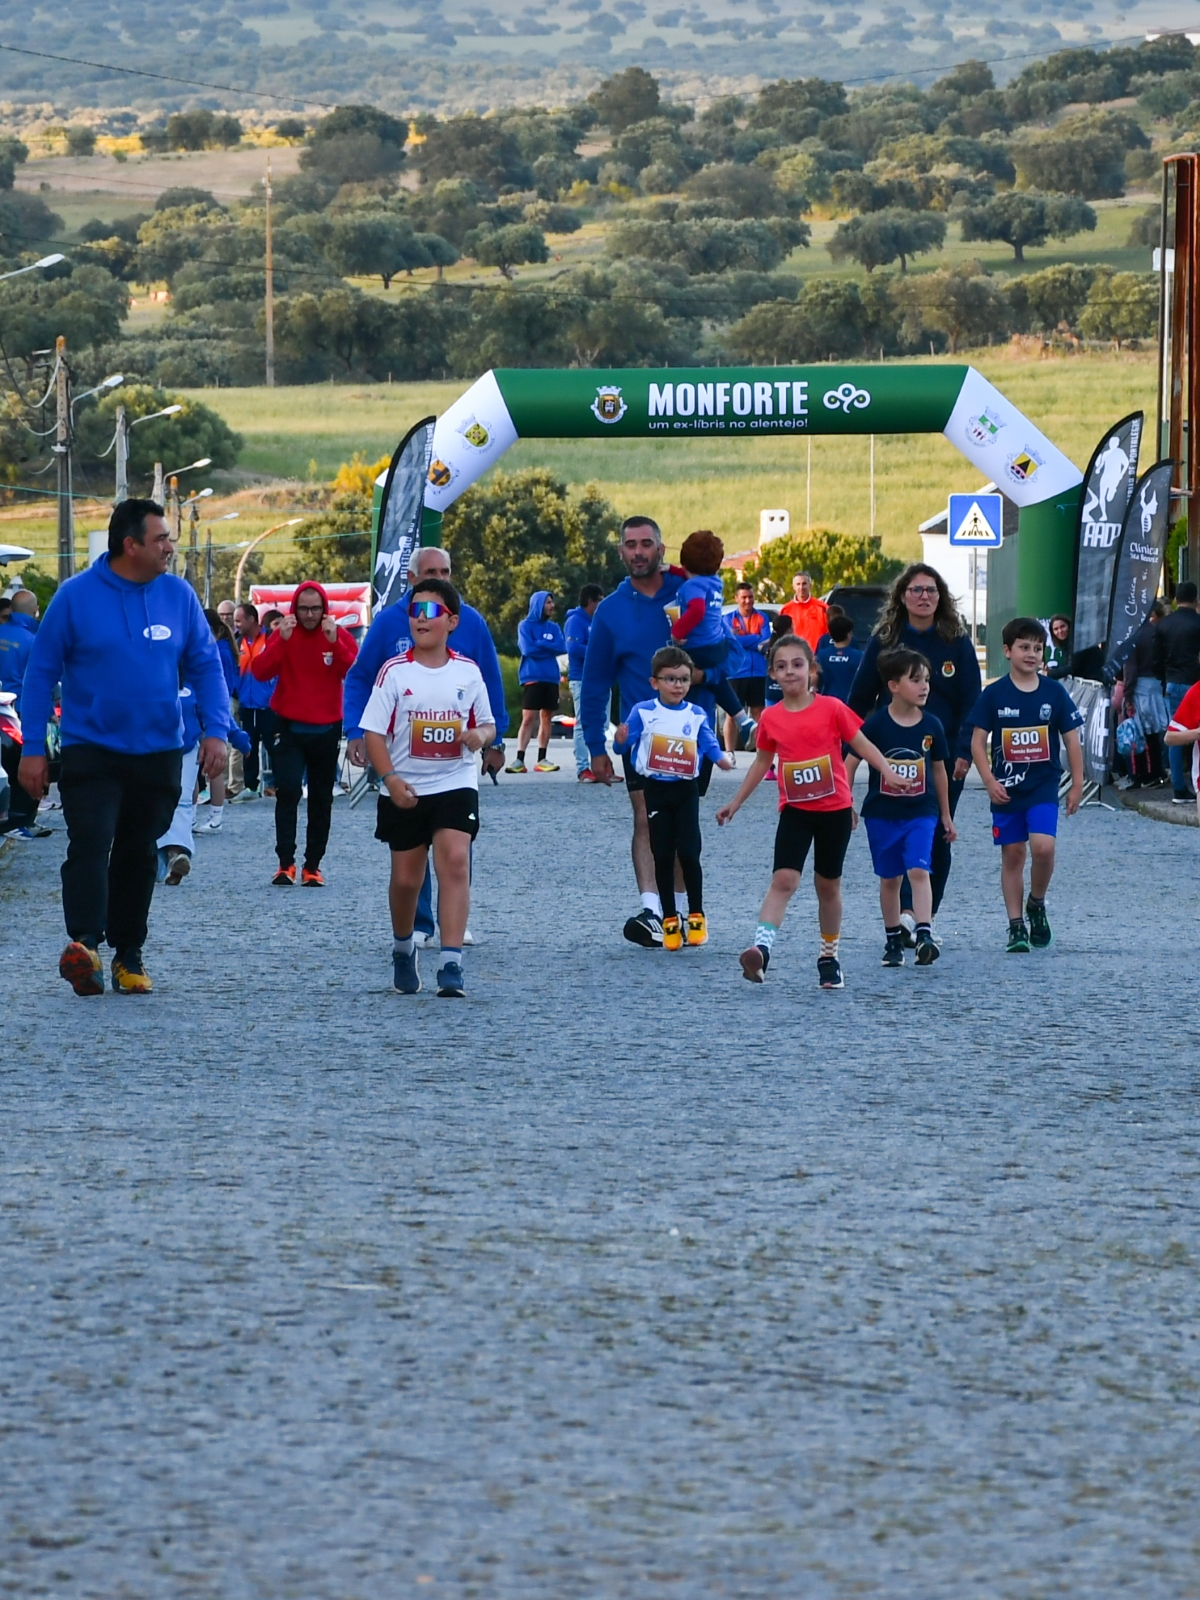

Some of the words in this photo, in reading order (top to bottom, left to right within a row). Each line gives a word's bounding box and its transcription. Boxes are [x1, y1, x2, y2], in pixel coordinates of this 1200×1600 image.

[648, 381, 809, 416] MONFORTE
[648, 420, 670, 430] um
[673, 418, 726, 430] ex-líbris
[729, 420, 746, 429] no
[750, 418, 809, 430] alentejo!
[1130, 541, 1159, 556] Clínica
[423, 727, 455, 744] 508
[1011, 730, 1040, 746] 300
[667, 739, 684, 756] 74
[793, 765, 821, 785] 501
